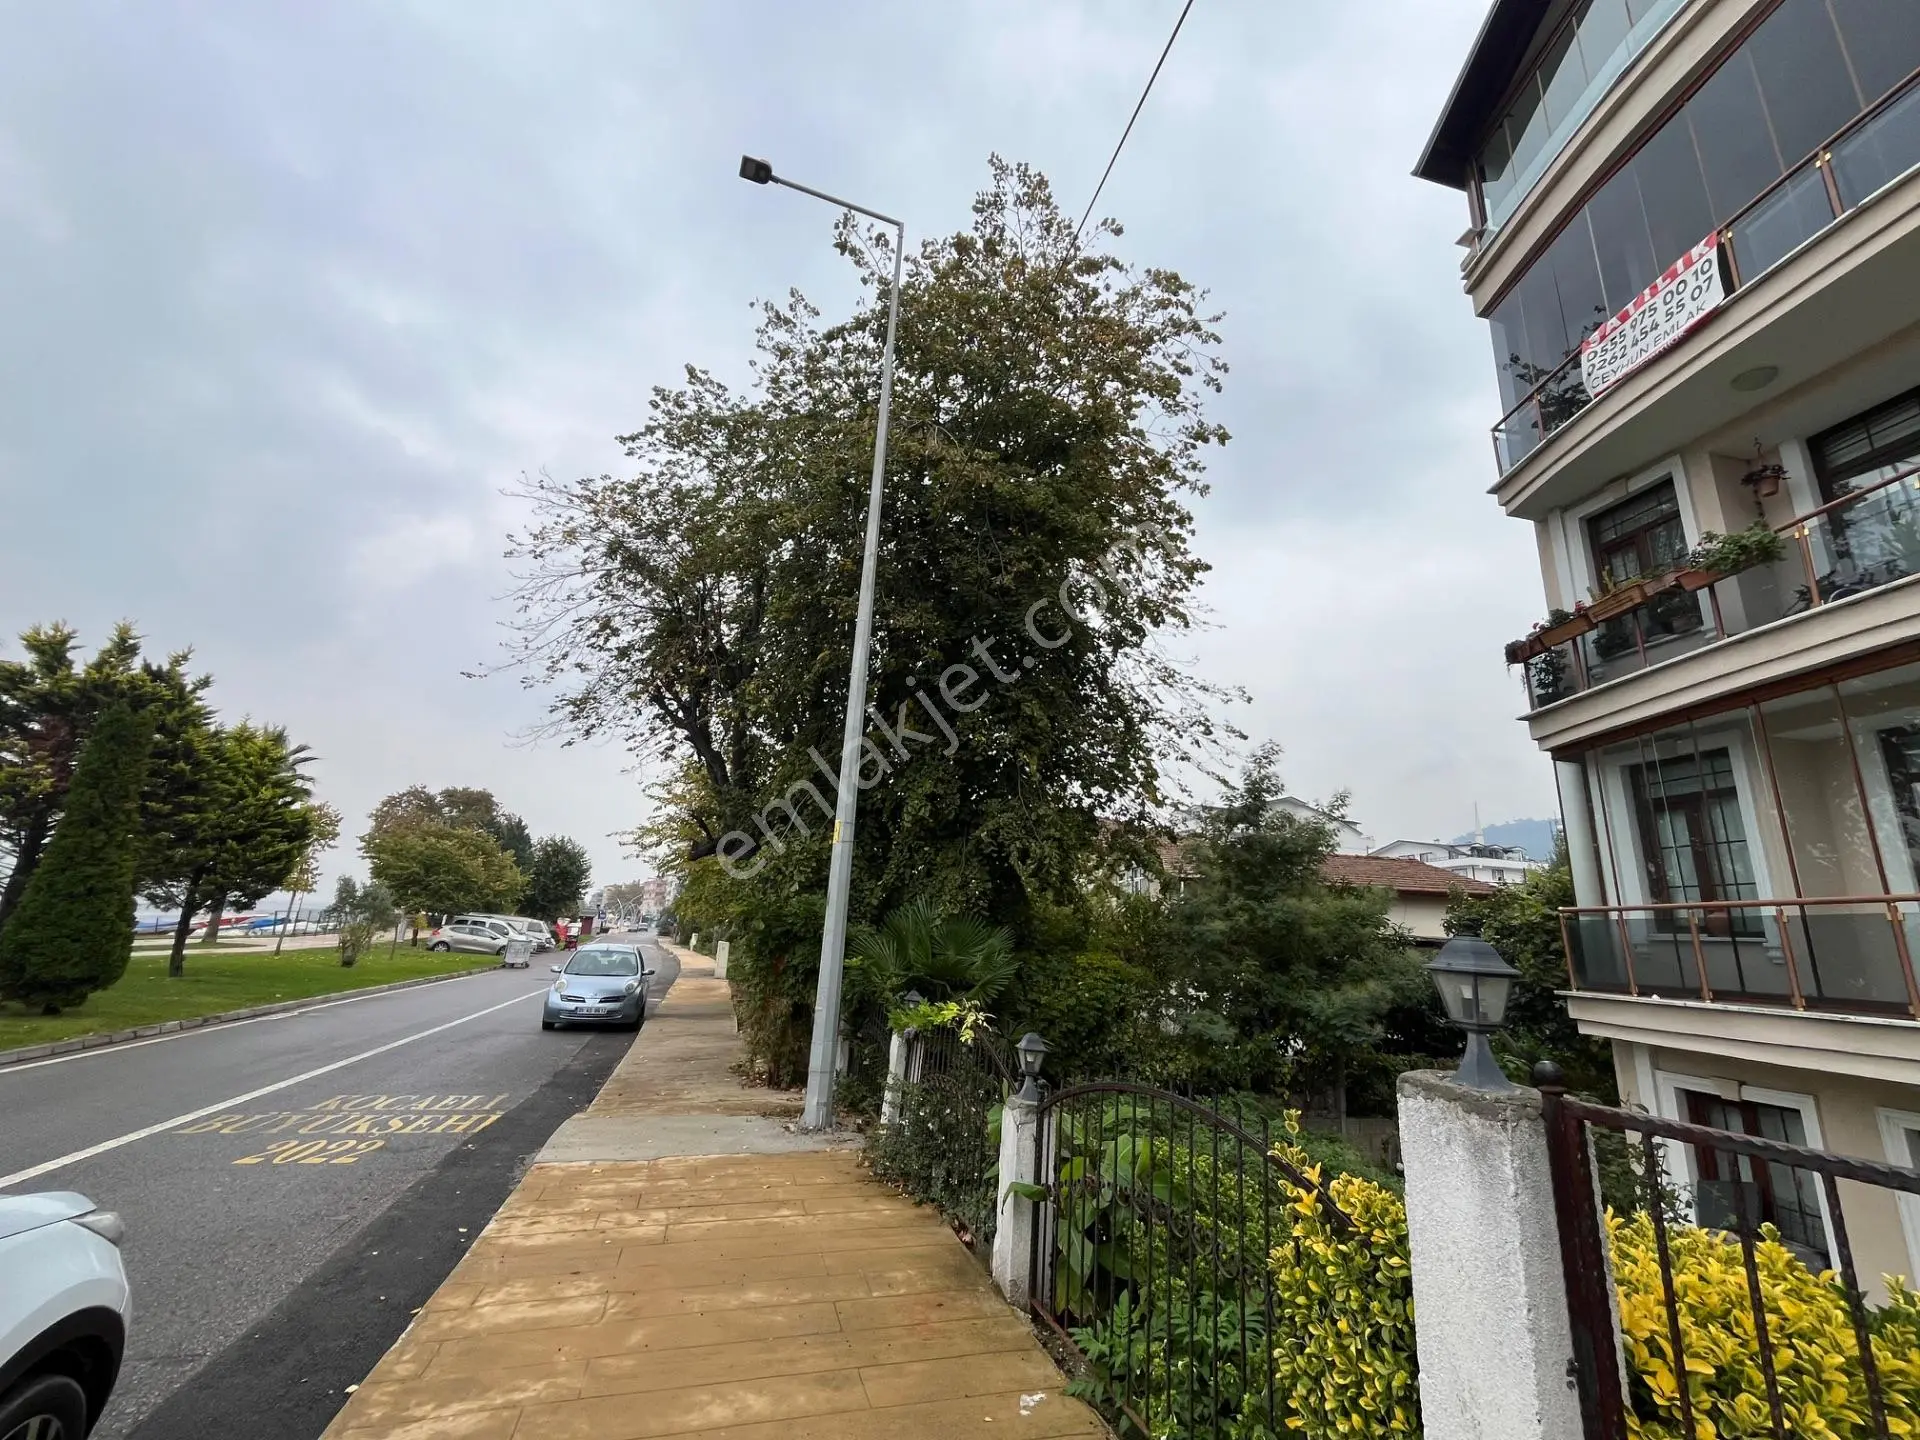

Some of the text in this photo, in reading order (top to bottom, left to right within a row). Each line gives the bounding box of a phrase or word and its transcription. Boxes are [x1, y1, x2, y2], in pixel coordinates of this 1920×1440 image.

[1586, 329, 1627, 363] 0555
[1629, 303, 1658, 332] 975
[1662, 279, 1688, 306] 00
[1692, 257, 1713, 282] 10
[1587, 347, 1628, 377] 0262
[1630, 319, 1660, 349] 454
[1664, 298, 1685, 324] 55
[1691, 273, 1714, 301] 07
[1591, 343, 1650, 390] CEYHUN
[1653, 300, 1707, 347] EMLAK
[231, 1139, 385, 1164] 2022
